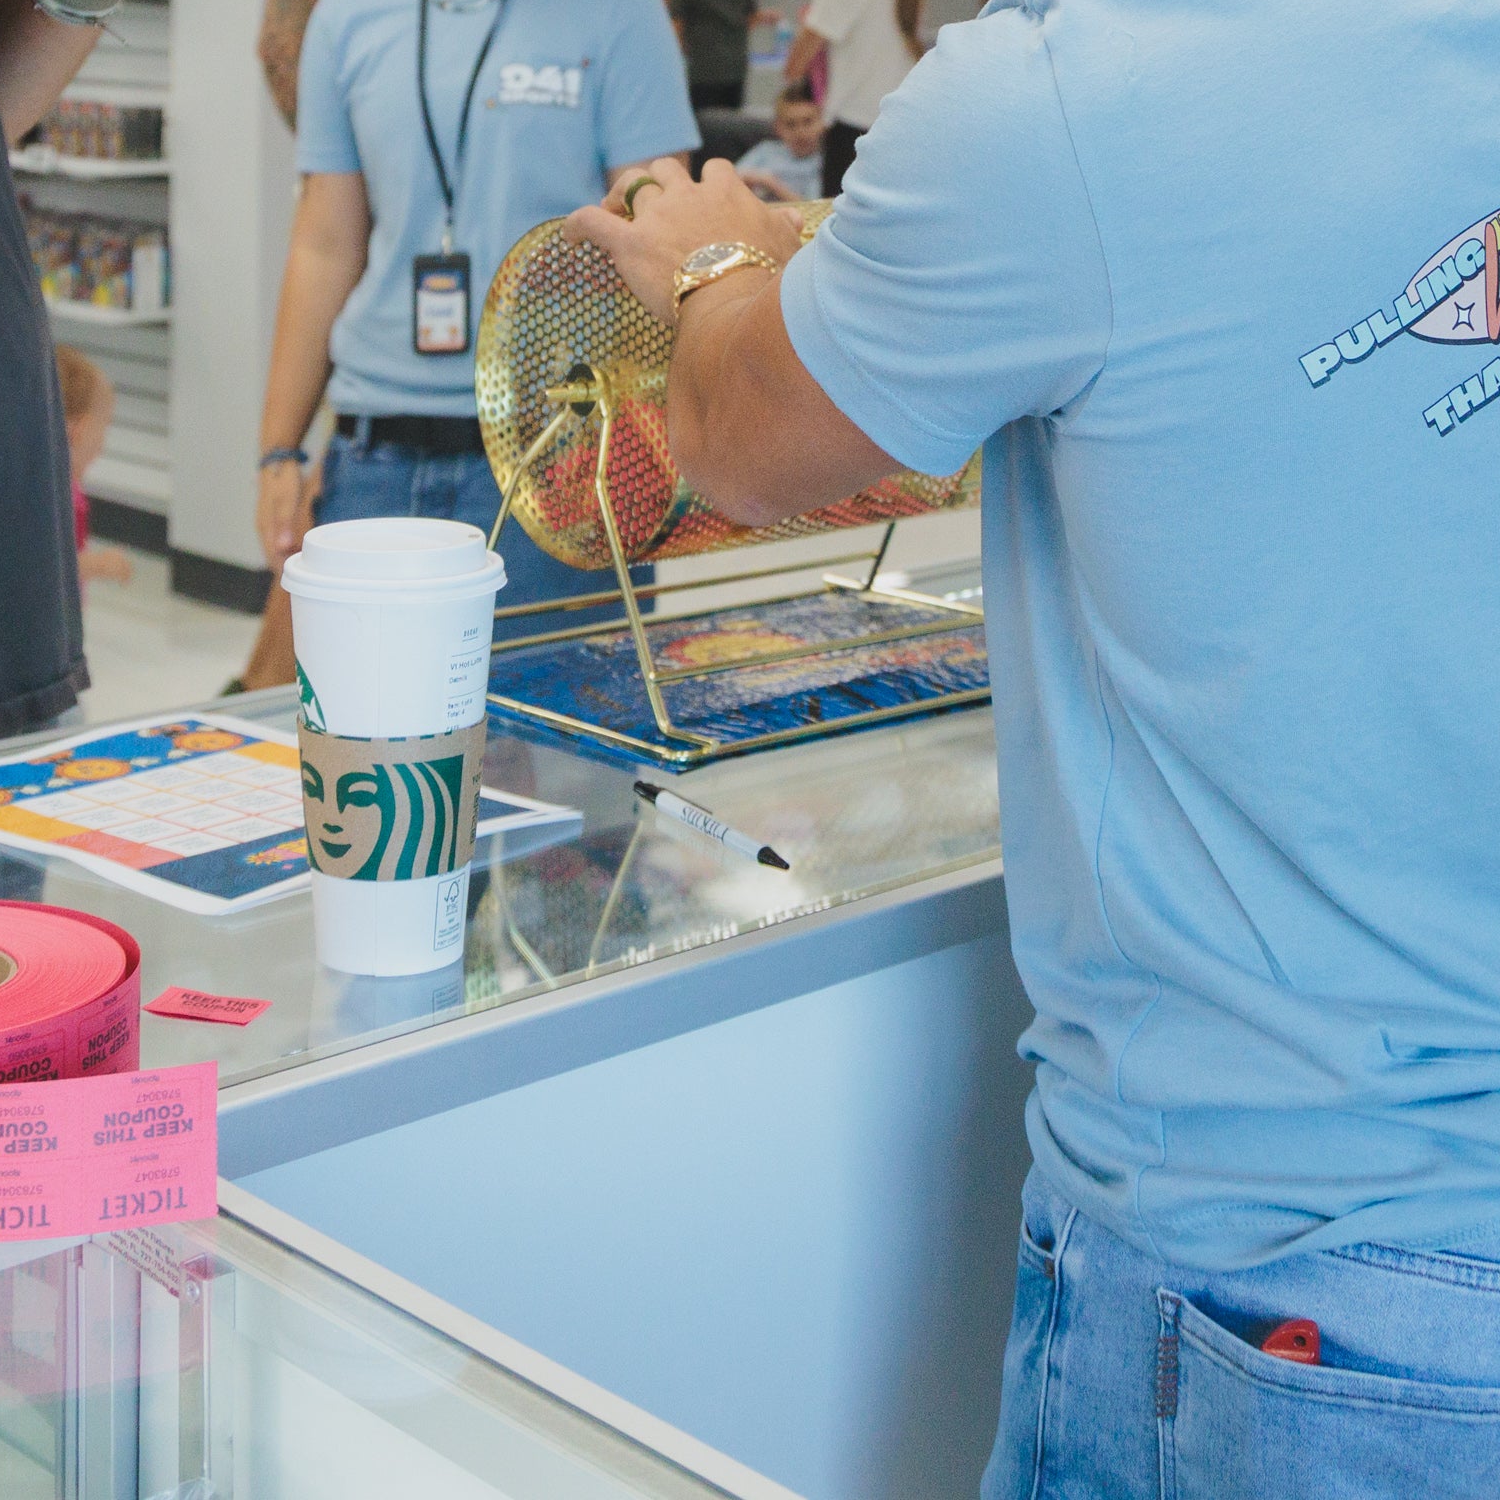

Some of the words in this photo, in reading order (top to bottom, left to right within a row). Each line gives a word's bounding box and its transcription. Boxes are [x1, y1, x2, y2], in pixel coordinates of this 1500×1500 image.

[1299, 237, 1486, 388] PULLING
[181, 992, 221, 1003] KEEP
[226, 1000, 260, 1009] THIS
[182, 1000, 247, 1013] COUPON
[103, 1103, 184, 1128] COUPON
[93, 1127, 136, 1146] THIS
[143, 1118, 193, 1138] KEEP
[4, 1137, 58, 1154] KEEP
[135, 1166, 180, 1183] 5783047
[99, 1186, 187, 1220] TICKET
